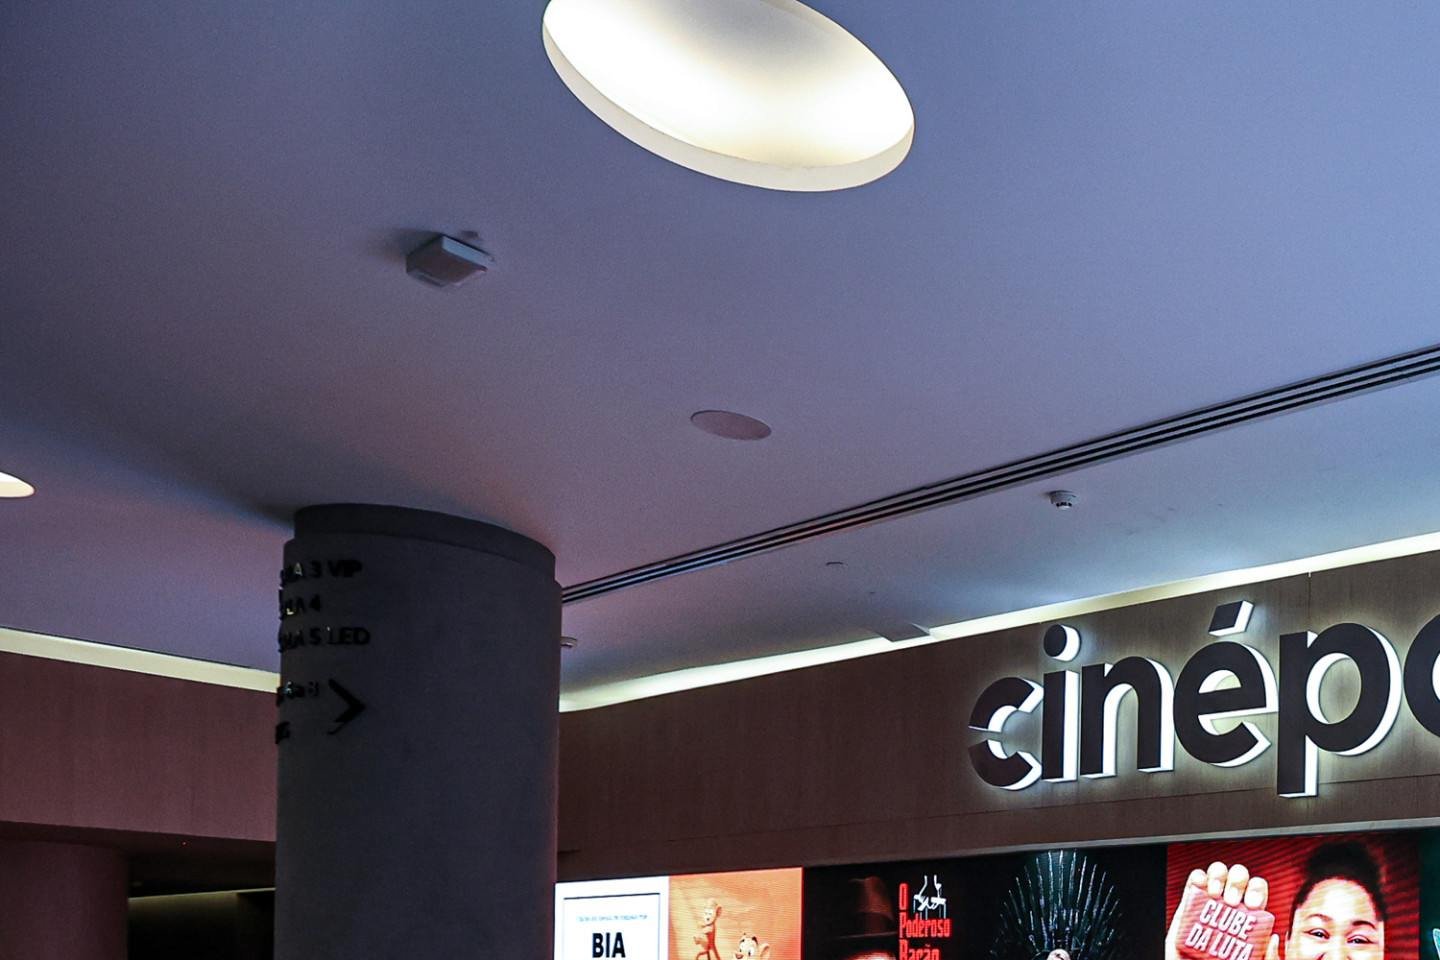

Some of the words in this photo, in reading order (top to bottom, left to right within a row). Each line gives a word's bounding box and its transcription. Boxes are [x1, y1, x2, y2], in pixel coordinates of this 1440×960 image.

[899, 883, 908, 911] O
[899, 911, 951, 938] Poderoso
[1200, 900, 1257, 940] CLUBE
[592, 932, 626, 958] BIA
[1185, 925, 1208, 951] DA
